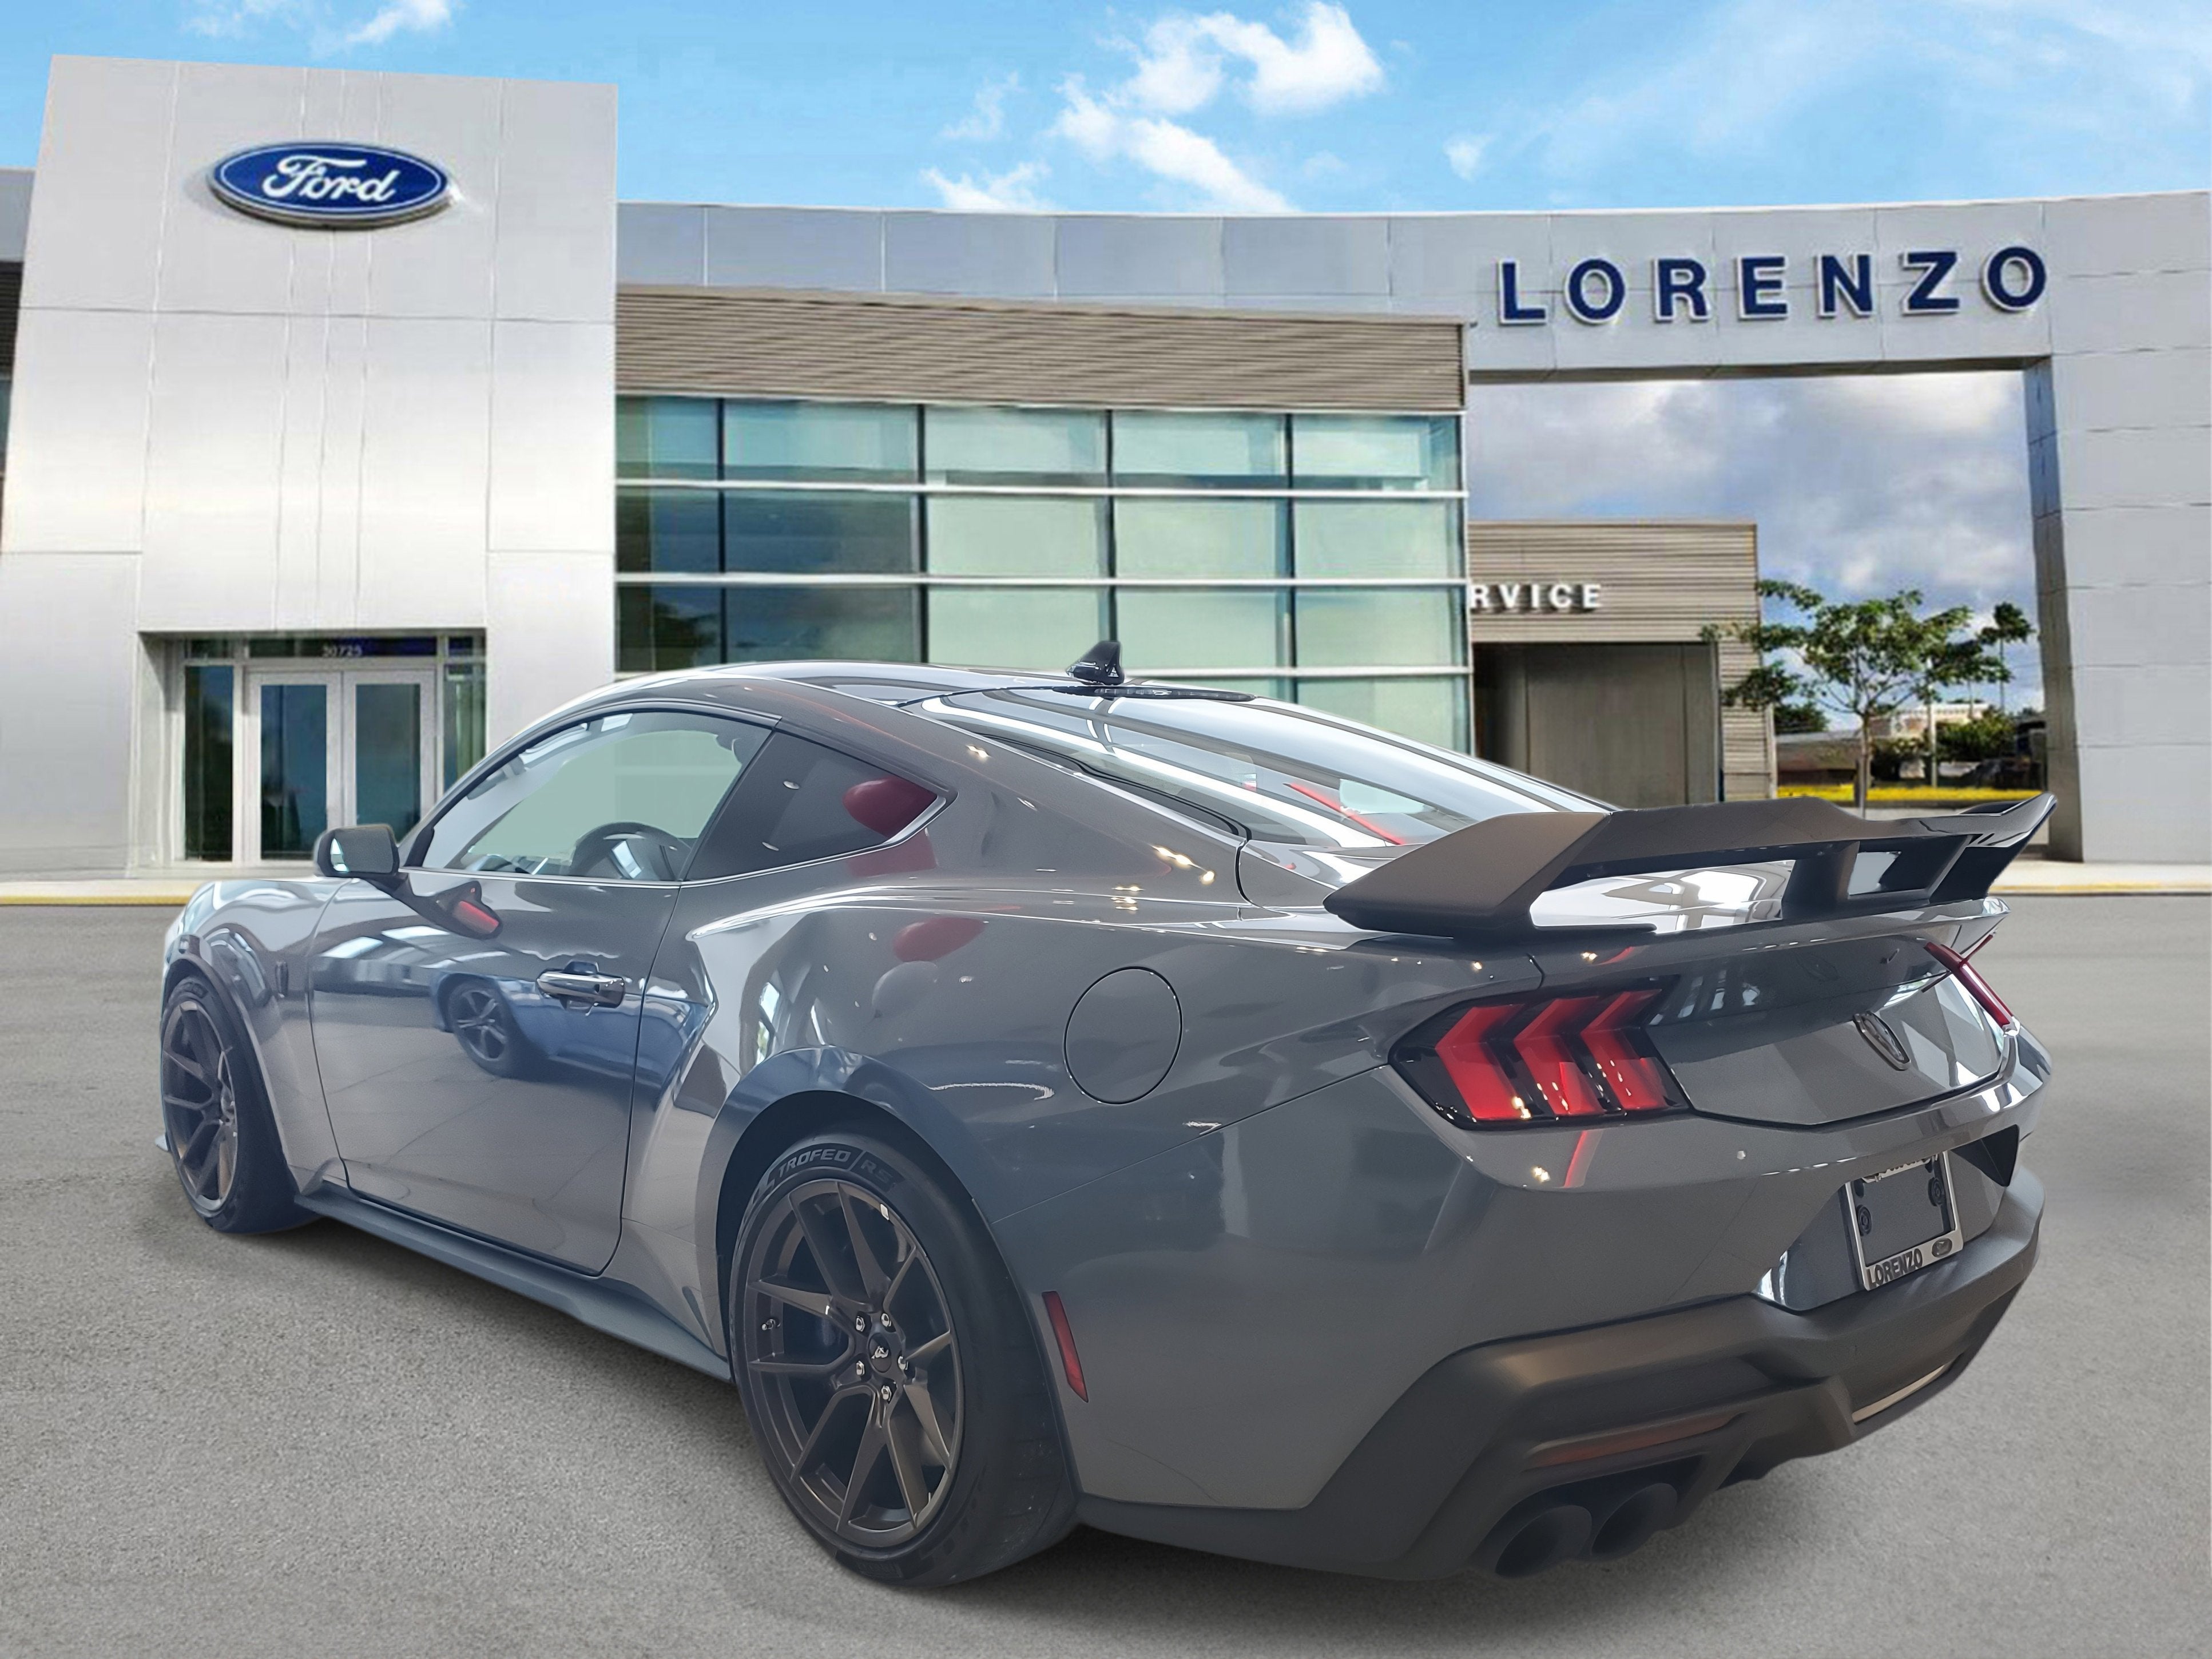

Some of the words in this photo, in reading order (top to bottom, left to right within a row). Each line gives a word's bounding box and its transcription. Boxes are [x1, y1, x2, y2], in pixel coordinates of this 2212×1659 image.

[261, 154, 400, 203] Ford
[1498, 246, 2048, 325] LORENZO
[1470, 584, 1601, 609] RVICE
[1867, 1248, 1923, 1287] LORENZO
